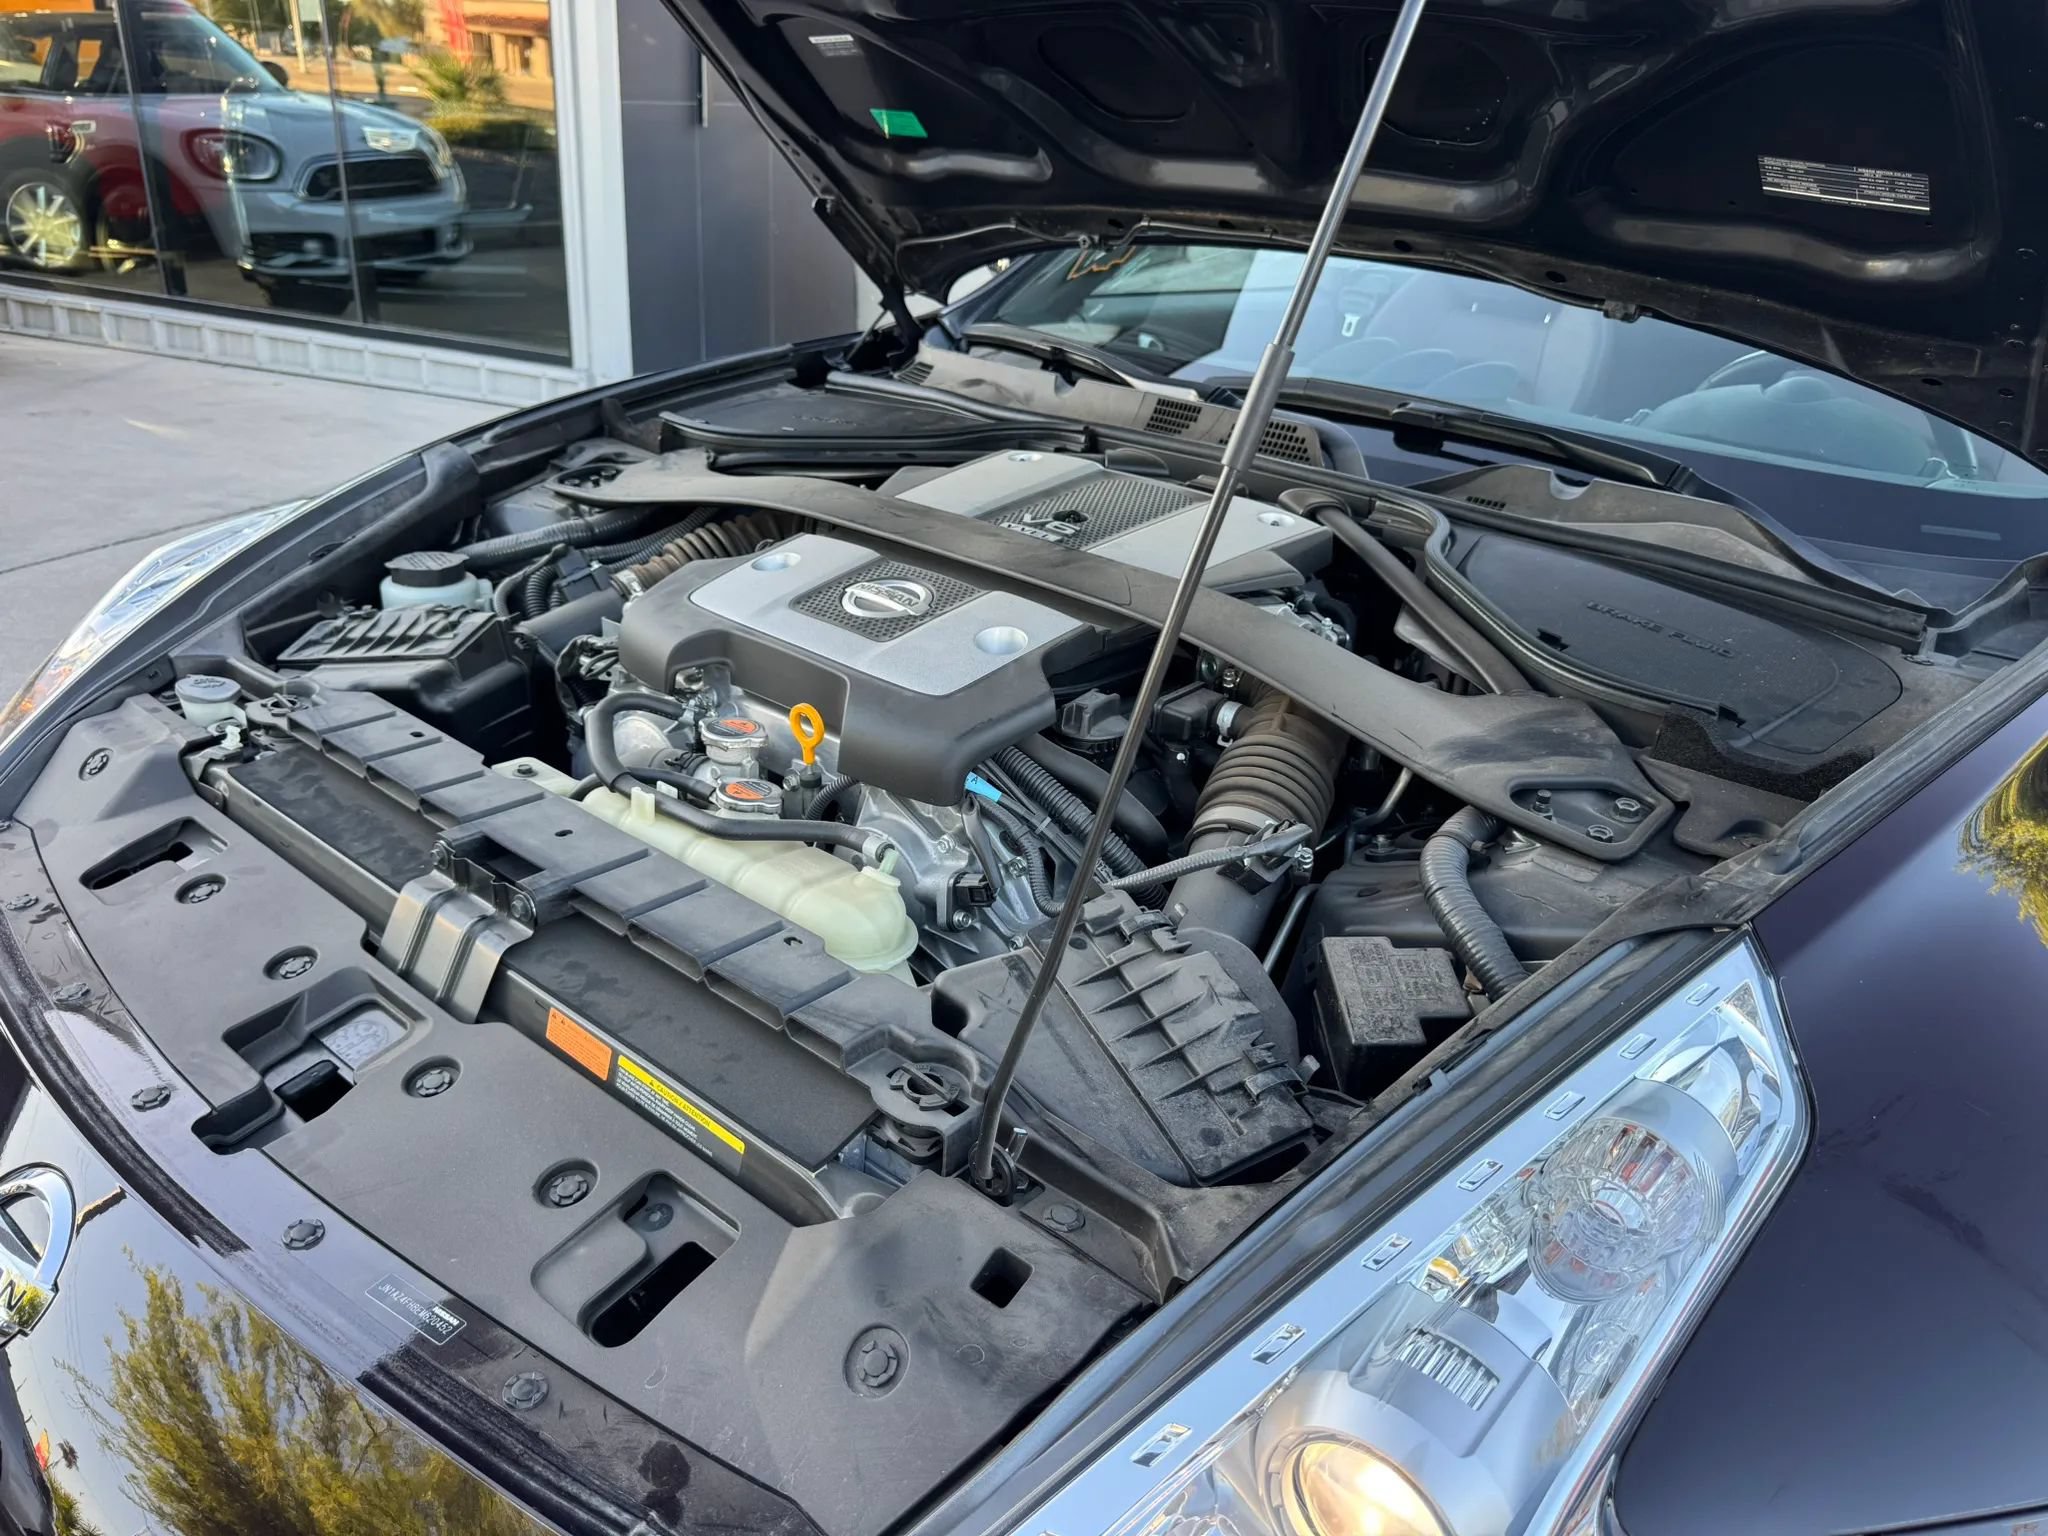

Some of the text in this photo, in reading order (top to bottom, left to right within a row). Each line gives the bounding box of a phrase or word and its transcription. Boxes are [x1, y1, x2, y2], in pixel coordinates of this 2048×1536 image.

[1023, 513, 1080, 535] V6
[854, 583, 919, 607] NISSAN
[1585, 600, 1737, 659] BRAKE FLUID
[656, 1084, 678, 1104] CAUTION
[683, 1105, 711, 1127] ATTENTION
[378, 1283, 453, 1335] JN1AZ4FH8EM620452
[432, 1306, 460, 1327] NISSAN
